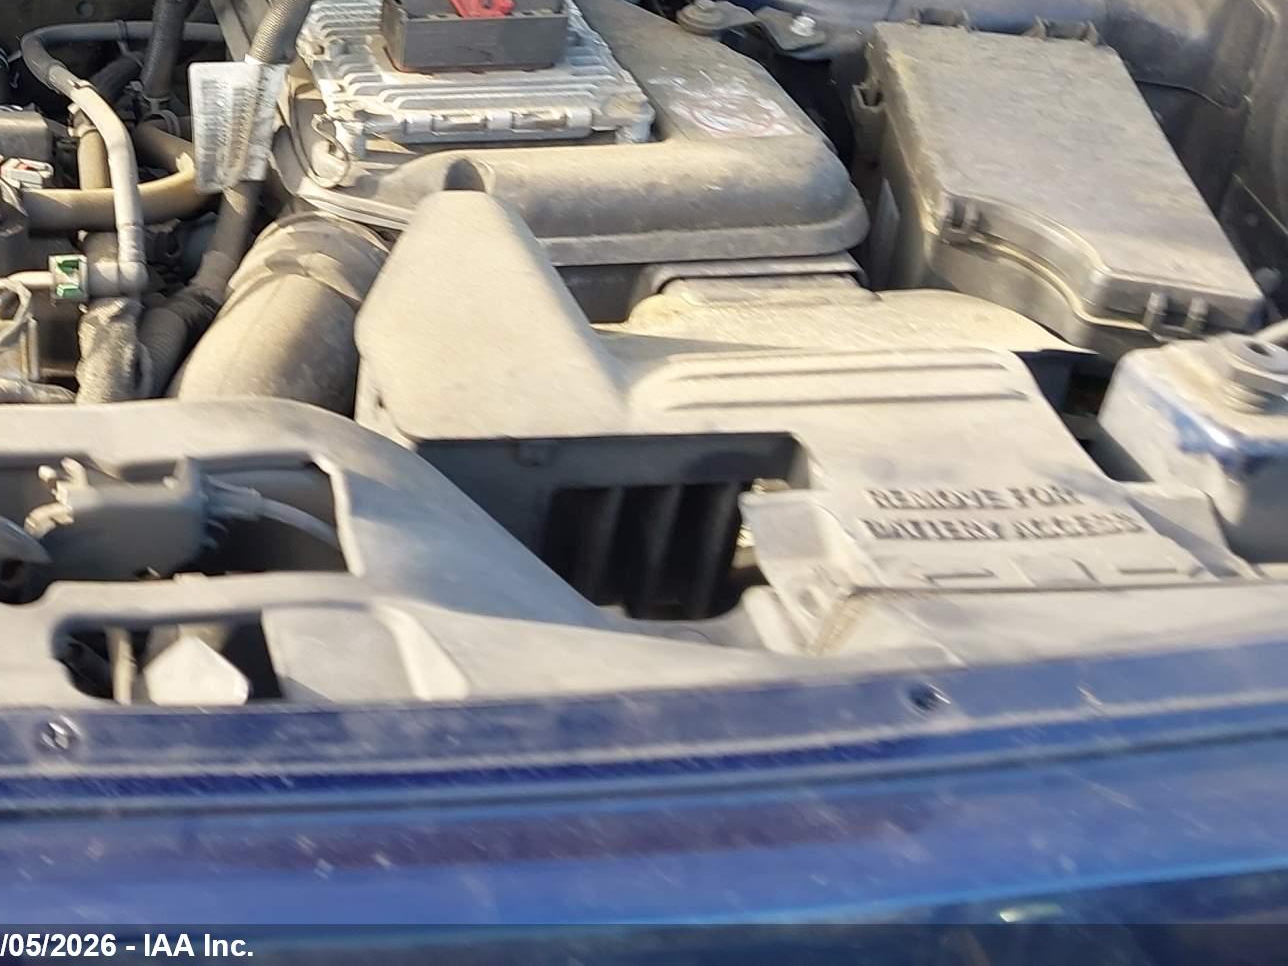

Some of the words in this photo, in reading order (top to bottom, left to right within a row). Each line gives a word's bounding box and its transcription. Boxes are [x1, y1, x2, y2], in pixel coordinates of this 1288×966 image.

[865, 488, 1012, 510] REMOVE
[1009, 485, 1086, 508] FOR
[859, 518, 1005, 540] BATTERY
[1011, 512, 1147, 538] ACCESS
